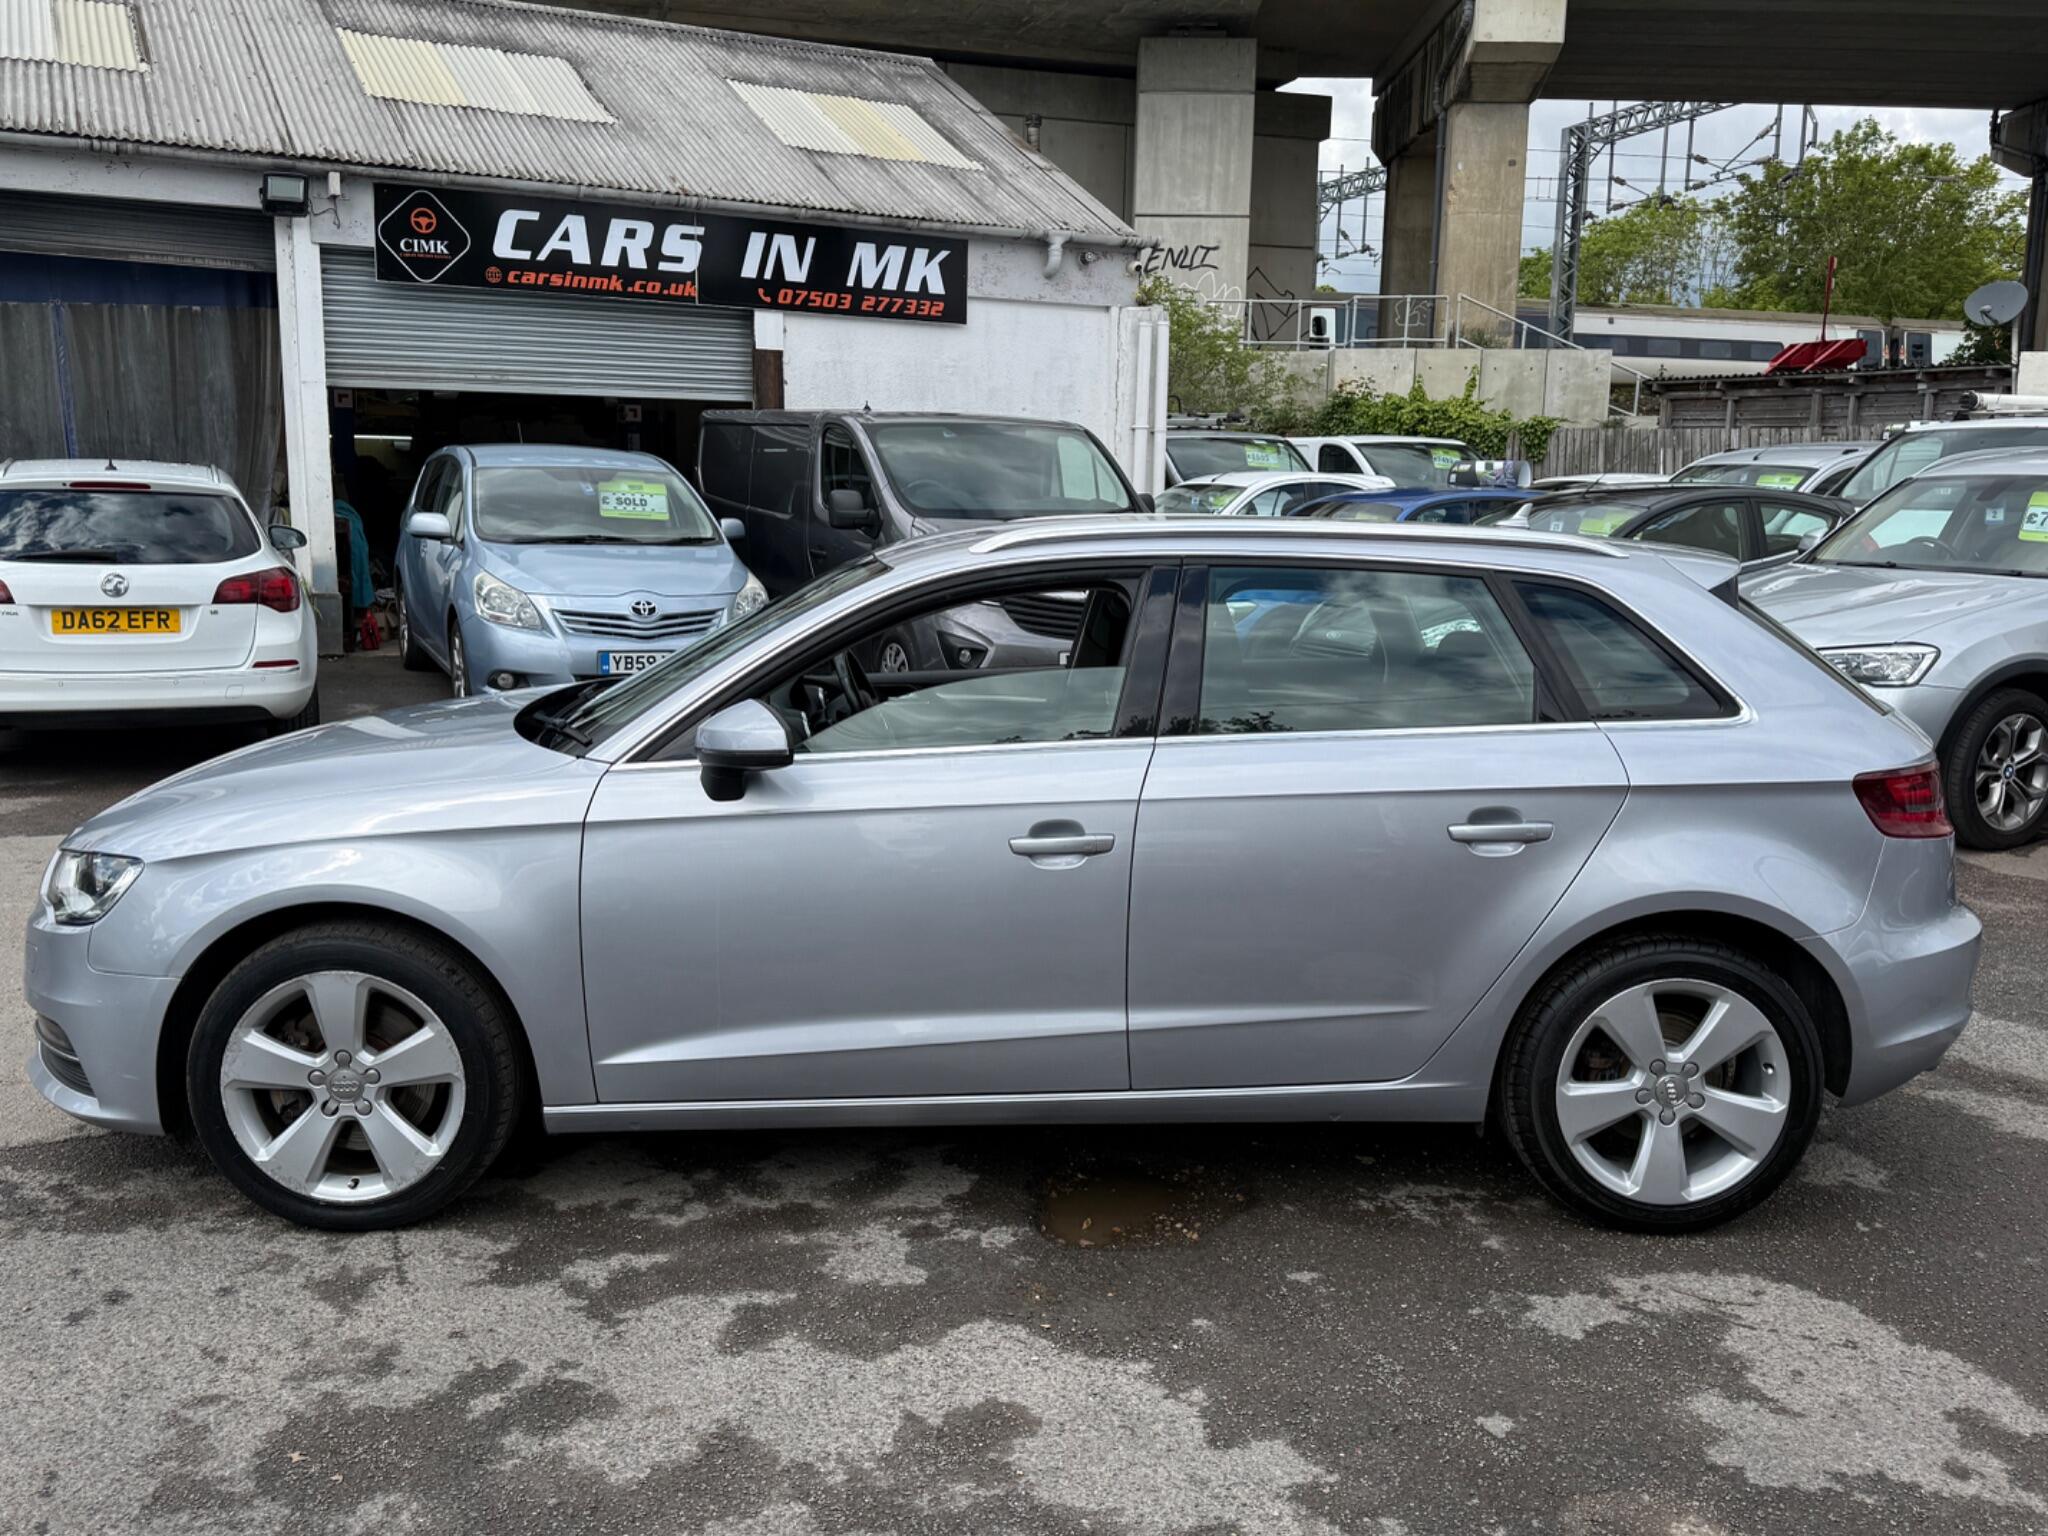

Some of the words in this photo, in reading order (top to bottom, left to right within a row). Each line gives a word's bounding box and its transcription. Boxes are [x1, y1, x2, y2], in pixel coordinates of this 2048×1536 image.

[400, 237, 450, 255] CIMK
[493, 209, 705, 273] CARS
[741, 231, 816, 283] IN
[846, 242, 951, 295] MK
[507, 269, 697, 297] carsinmk.co.uk
[778, 288, 852, 309] 07503
[861, 296, 945, 317] 277332
[616, 497, 647, 507] SOLD
[61, 611, 120, 629] DA62
[127, 611, 170, 629] EFR
[612, 655, 657, 671] YB59
